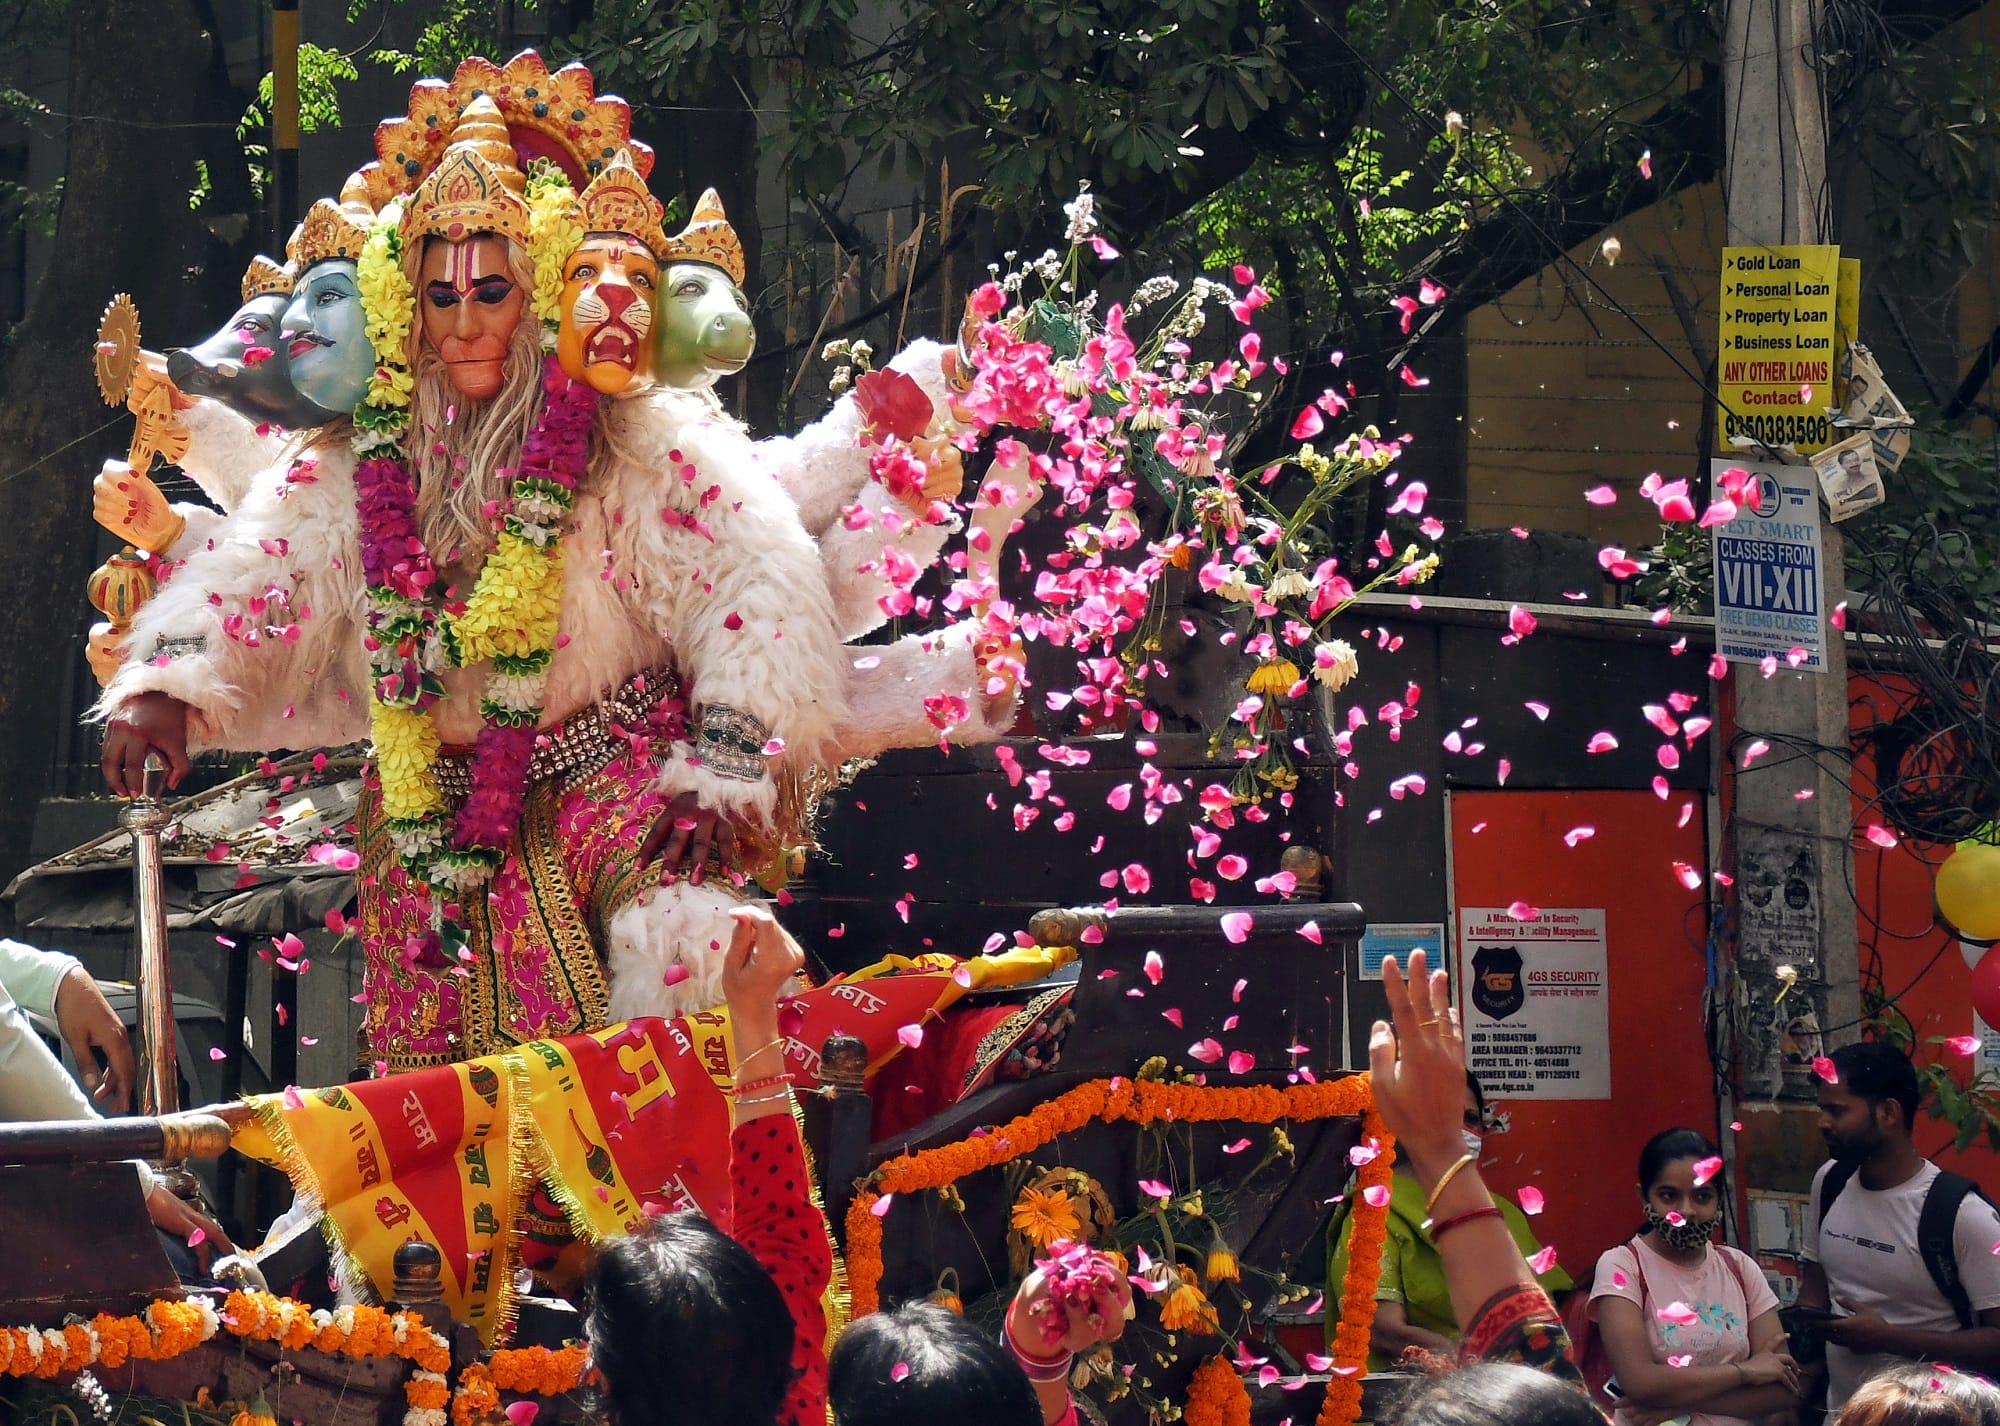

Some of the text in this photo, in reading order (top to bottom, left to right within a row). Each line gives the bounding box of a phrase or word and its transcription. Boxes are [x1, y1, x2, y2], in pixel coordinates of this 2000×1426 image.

[1737, 256, 1800, 269] Gold Loan
[1736, 282, 1830, 296] Personal Loan
[1736, 309, 1827, 326] Property Loan
[1735, 335, 1830, 349] Business Loan
[1724, 362, 1828, 382] ANY OTHER LOANS
[1760, 521, 1814, 541] SMART
[1721, 539, 1812, 566] CLASSES FROM
[1721, 560, 1814, 613] VII-XII
[1720, 609, 1818, 634] FREE DEMO CLASSES
[1553, 914, 1579, 925] Security
[1469, 926, 1474, 935] &
[1528, 971, 1600, 982] 4GS SECURITY
[704, 1034, 728, 1079] राम
[1472, 1046, 1491, 1055] AREA
[1493, 1046, 1528, 1055] MANAGER
[1472, 1058, 1497, 1067] OFFICE
[1508, 1071, 1527, 1079] HEAD
[402, 1090, 438, 1150] राम
[357, 1140, 382, 1190] जय
[464, 1141, 491, 1188] जय
[473, 1202, 500, 1238] श्री
